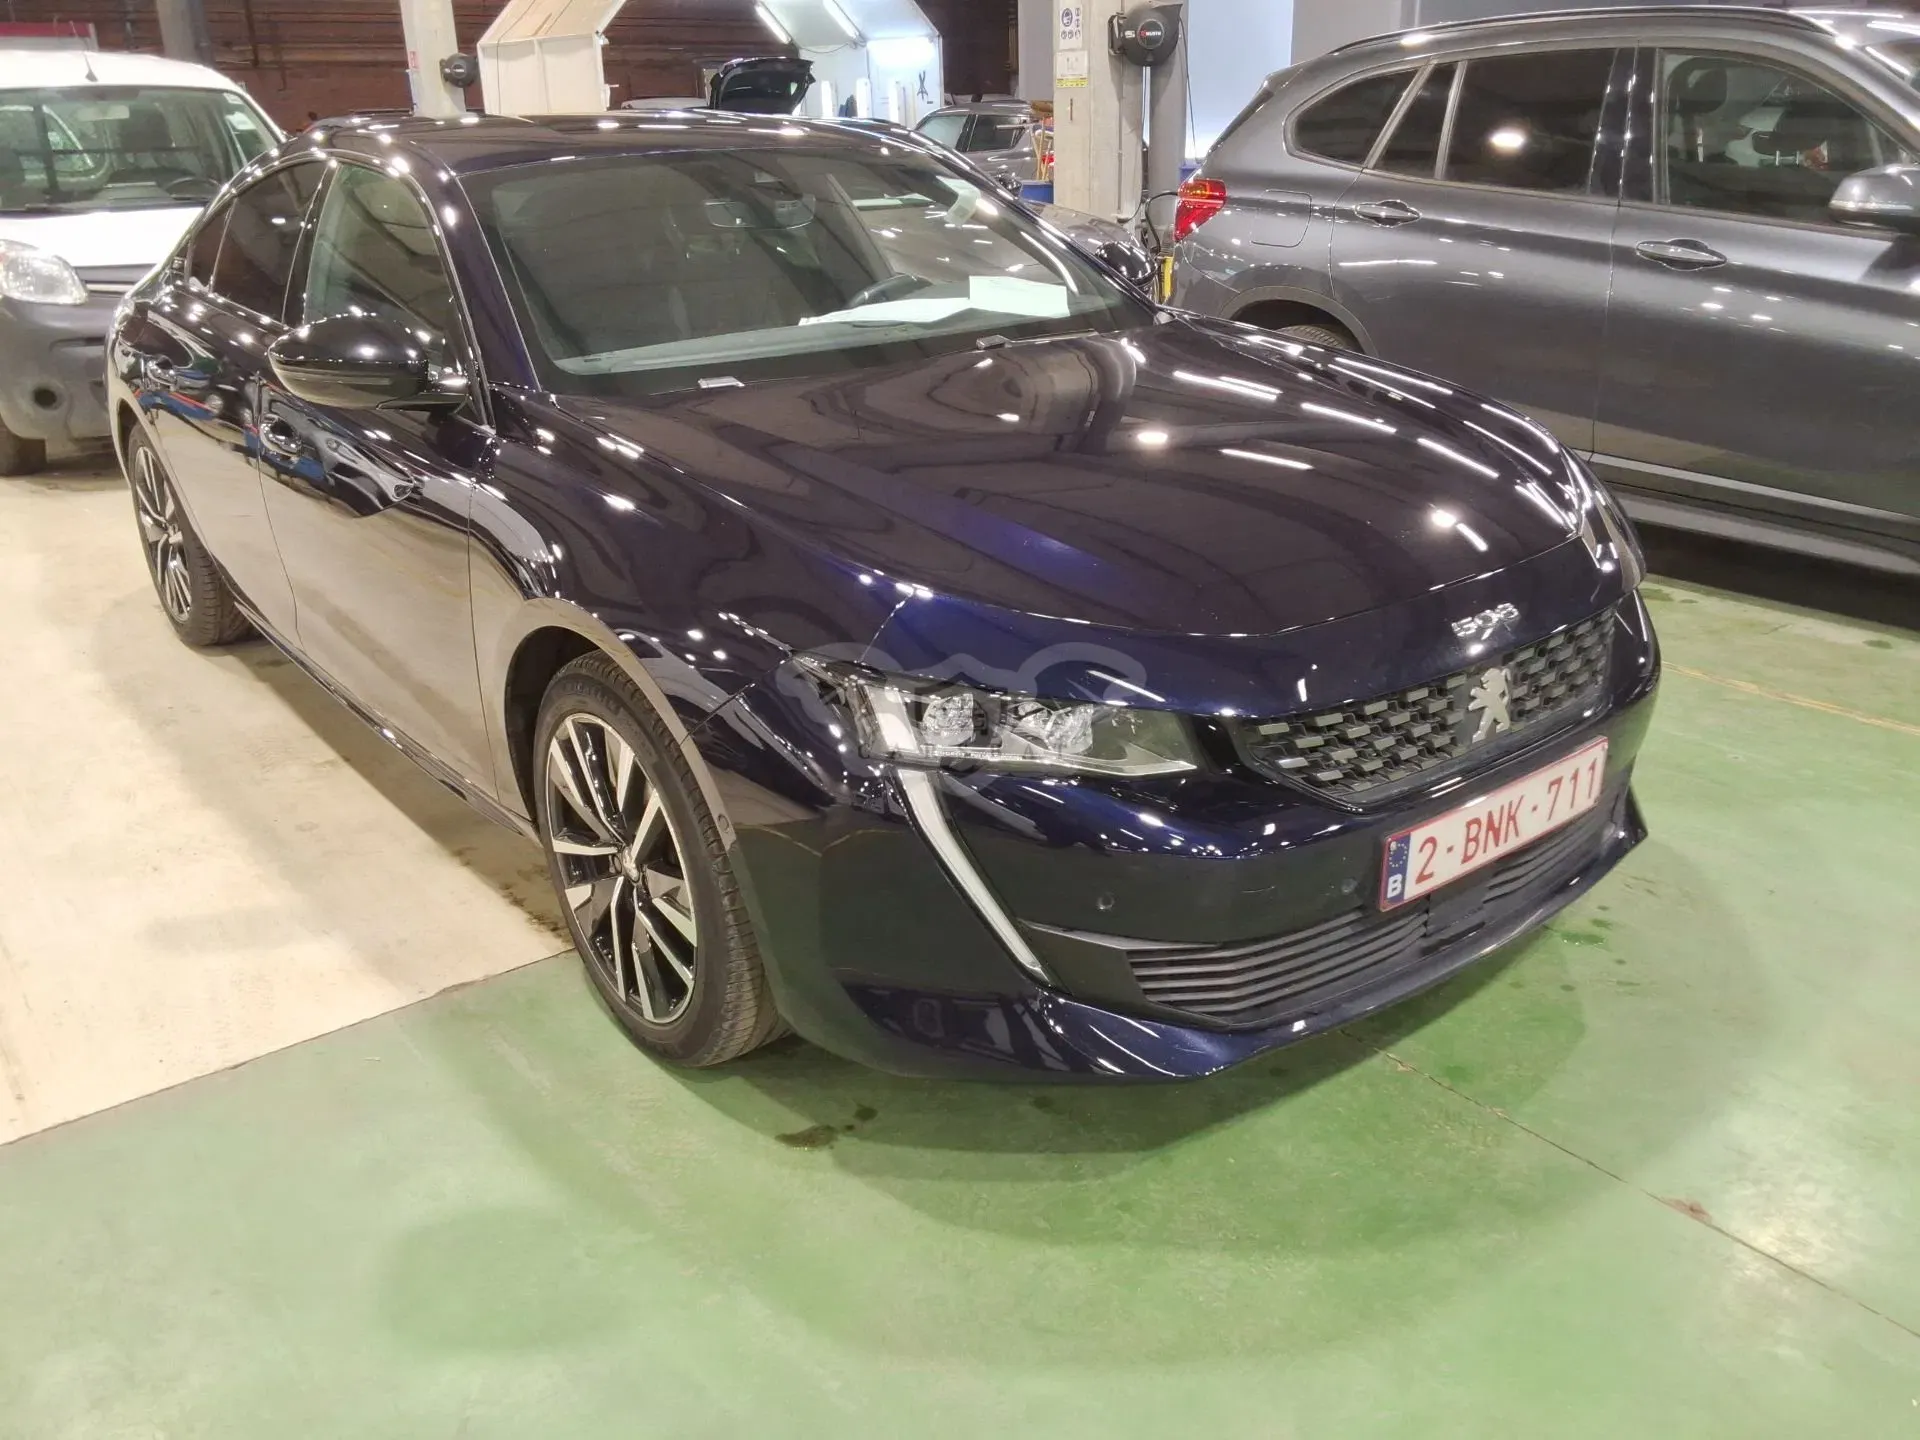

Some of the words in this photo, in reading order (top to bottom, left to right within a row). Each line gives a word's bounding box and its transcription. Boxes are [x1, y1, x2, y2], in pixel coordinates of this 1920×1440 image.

[1451, 602, 1520, 638] 508
[1415, 757, 1598, 885] 2-BNK-711
[1386, 873, 1403, 899] B
